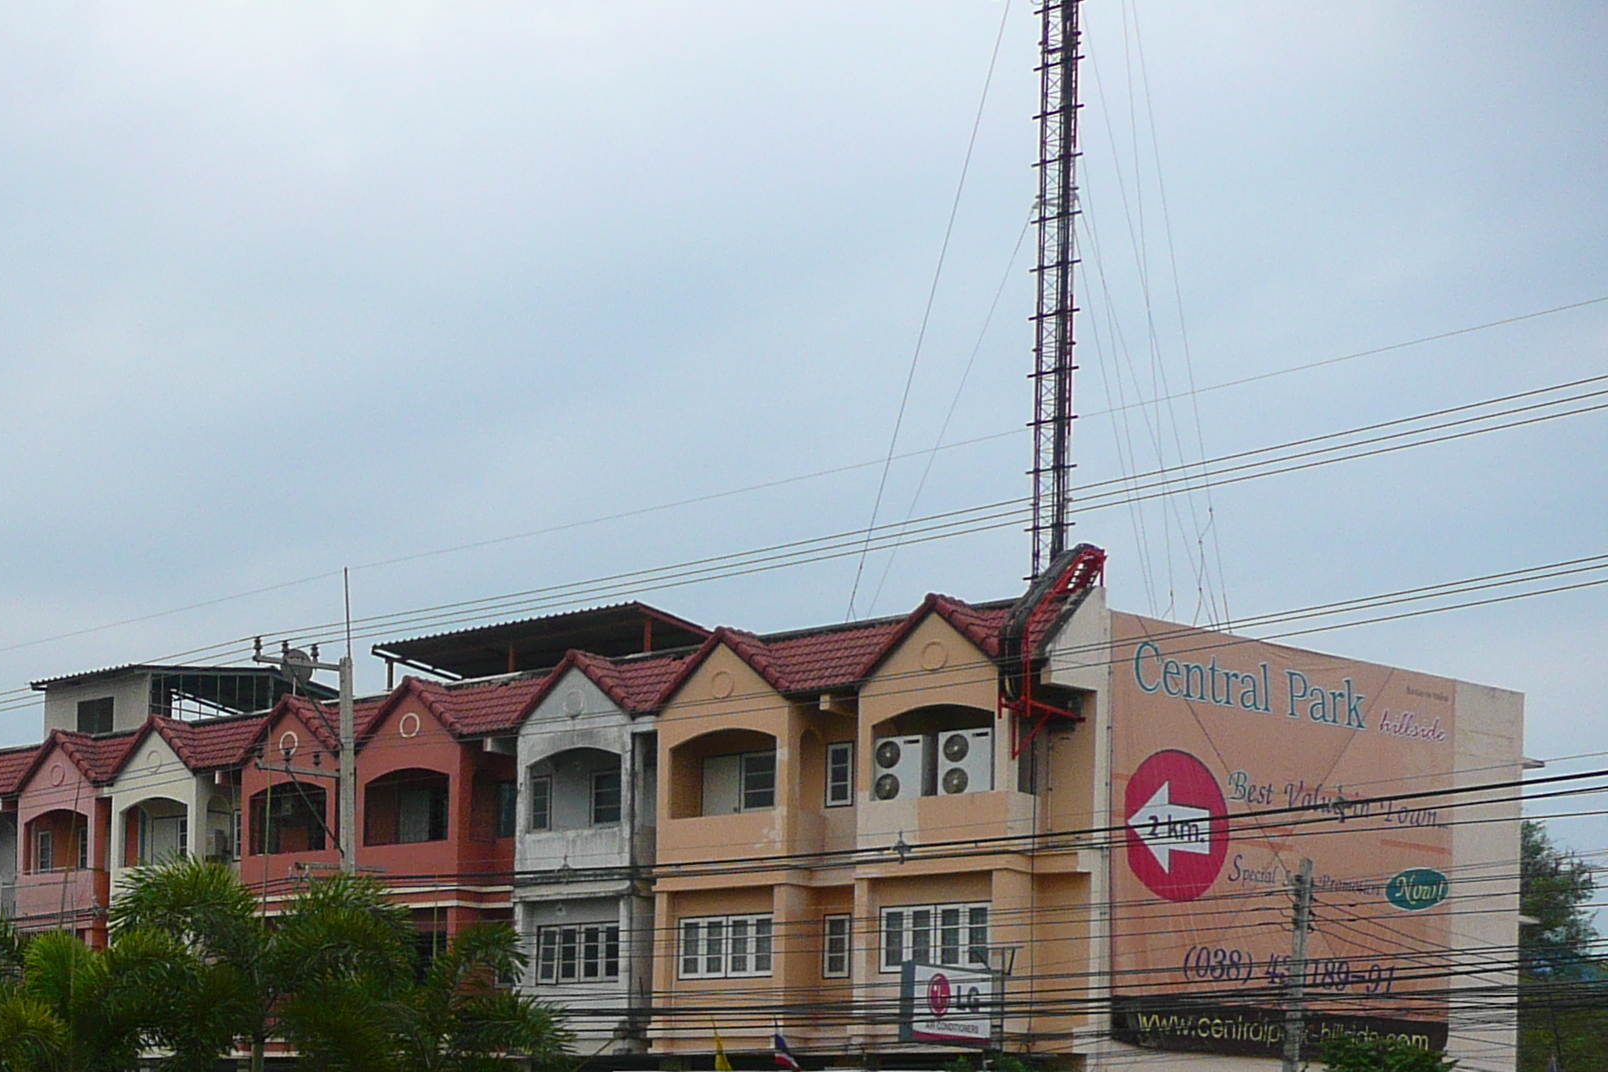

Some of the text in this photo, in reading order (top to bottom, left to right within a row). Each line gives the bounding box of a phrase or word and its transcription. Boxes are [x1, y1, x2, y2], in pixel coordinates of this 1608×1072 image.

[1134, 641, 1367, 731] Central Park
[1379, 708, 1445, 742] hillside
[1227, 770, 1274, 805] Best
[1147, 814, 1205, 843] 2 km.
[1228, 853, 1278, 887] Special
[1395, 876, 1444, 905] Now!
[1183, 946, 1253, 986] (038)
[956, 985, 980, 1012] LG
